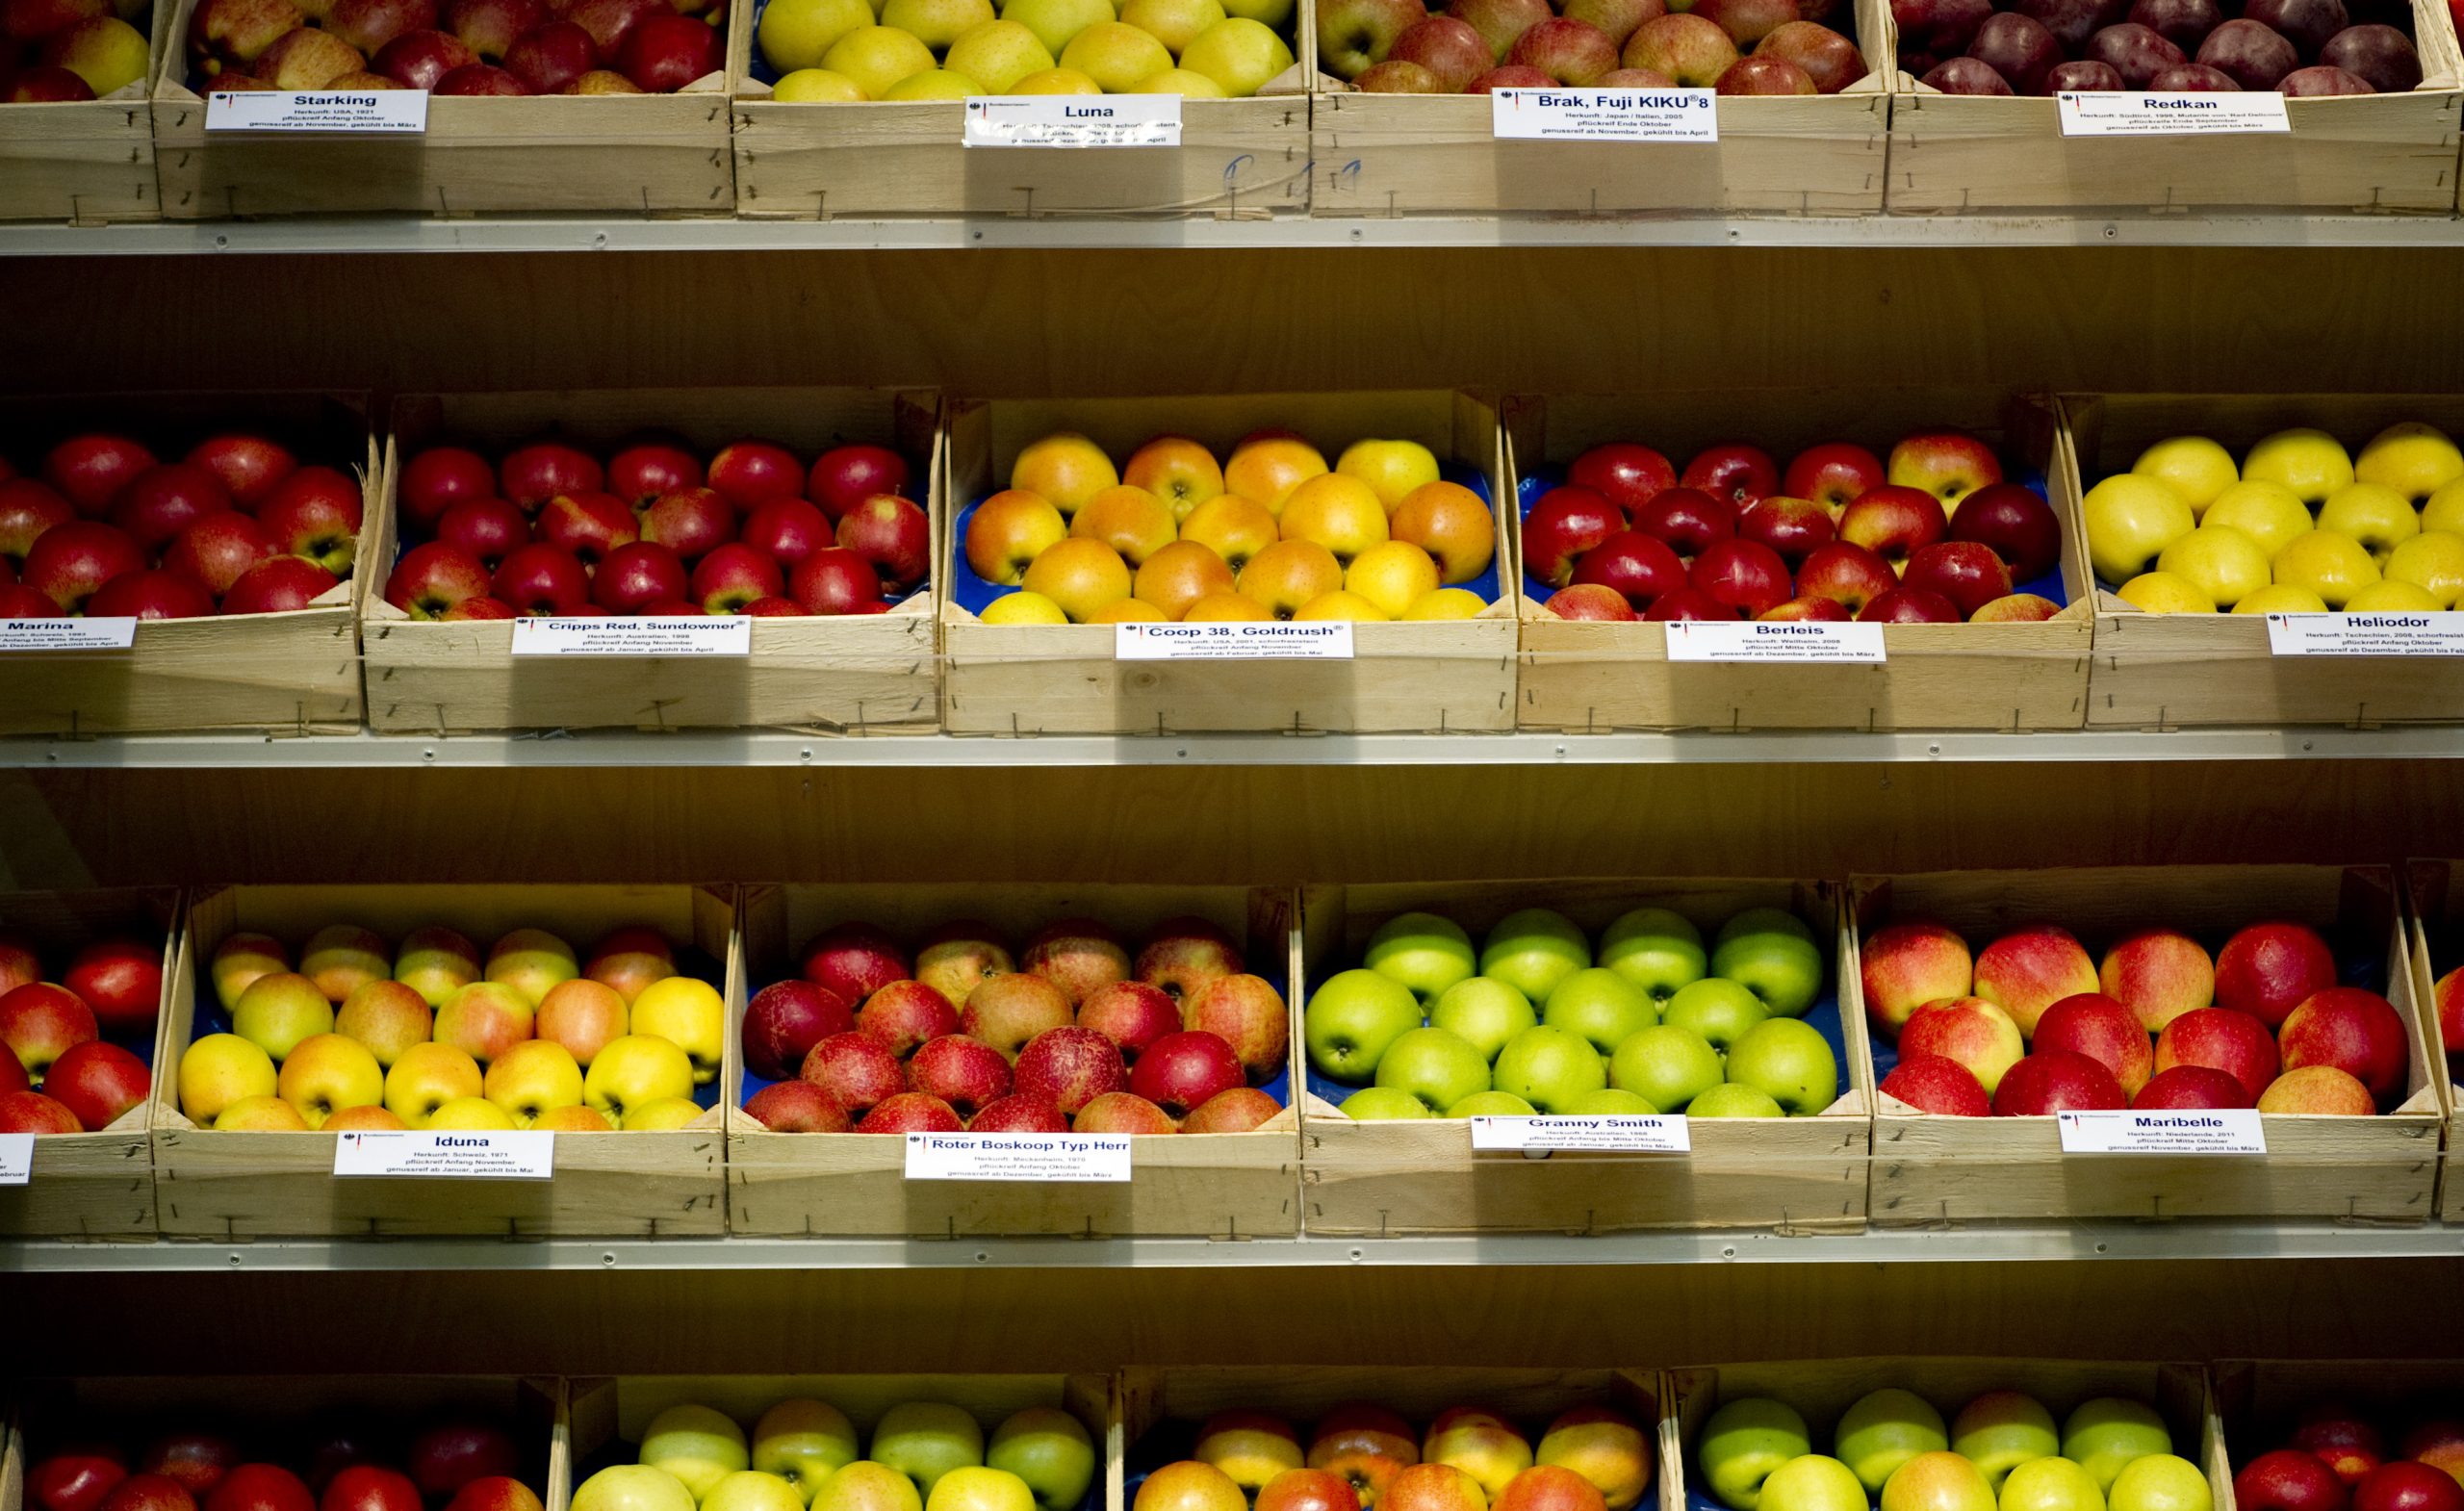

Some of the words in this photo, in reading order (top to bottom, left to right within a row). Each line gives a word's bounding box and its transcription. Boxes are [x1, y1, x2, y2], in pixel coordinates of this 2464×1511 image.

[295, 96, 376, 106] Starking
[1539, 96, 1589, 111] Brak,
[1597, 95, 1632, 111] Fuji
[2144, 99, 2218, 109] Redkan
[1065, 107, 1114, 117] Luna
[549, 623, 601, 631] Cripps
[605, 622, 640, 631] Red,
[2348, 617, 2429, 627] Heliodor
[1149, 627, 1201, 638] Coop
[1208, 627, 1235, 638] 38,
[1757, 626, 1824, 635] Berleis
[1529, 1119, 1600, 1129] Granny
[2136, 1118, 2223, 1127] Maribelle
[436, 1137, 489, 1147] Iduna
[933, 1140, 975, 1149] Roter
[982, 1140, 1054, 1151] Boskoop
[1062, 1140, 1089, 1151] Typ
[1094, 1141, 1127, 1150] Herr
